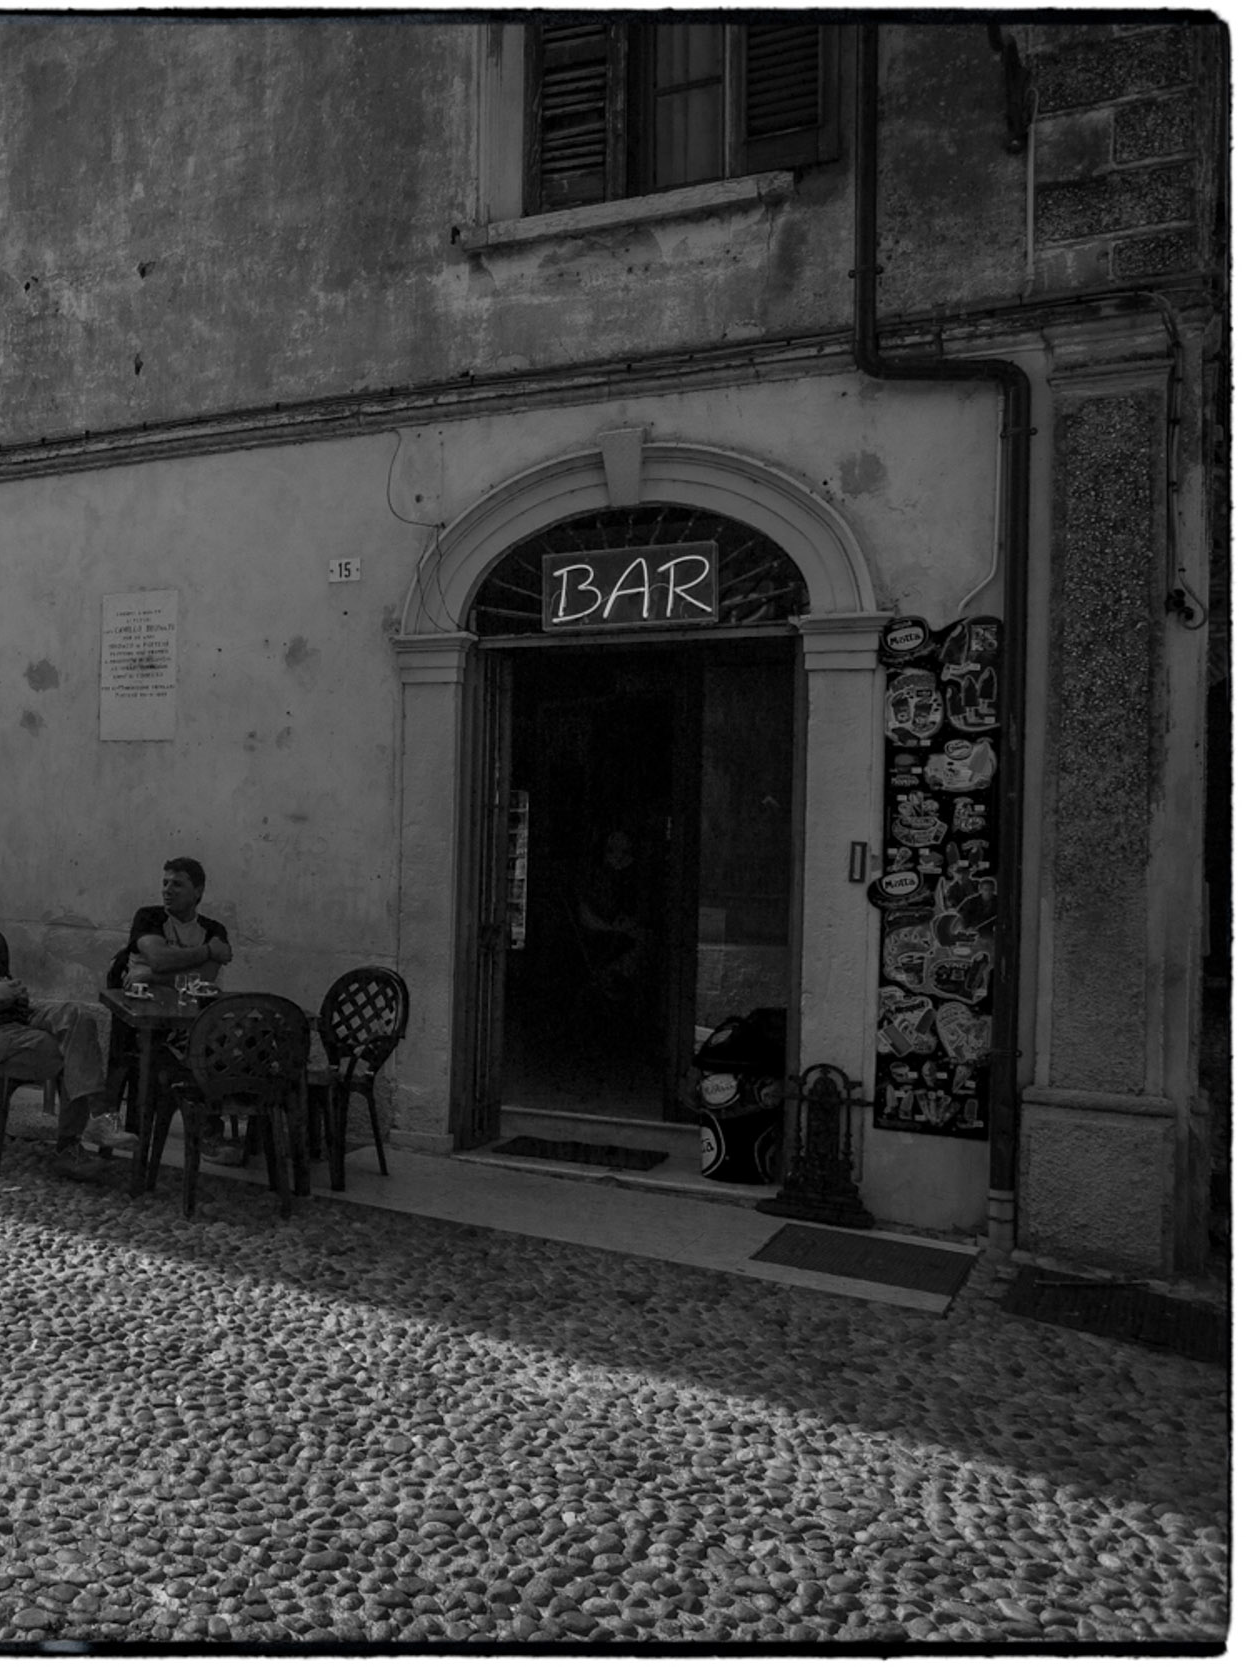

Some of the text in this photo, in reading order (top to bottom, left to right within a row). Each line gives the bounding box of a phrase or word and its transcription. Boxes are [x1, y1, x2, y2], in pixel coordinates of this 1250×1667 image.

[338, 561, 351, 578] 15
[552, 554, 713, 624] BAR
[890, 633, 921, 646] Motta
